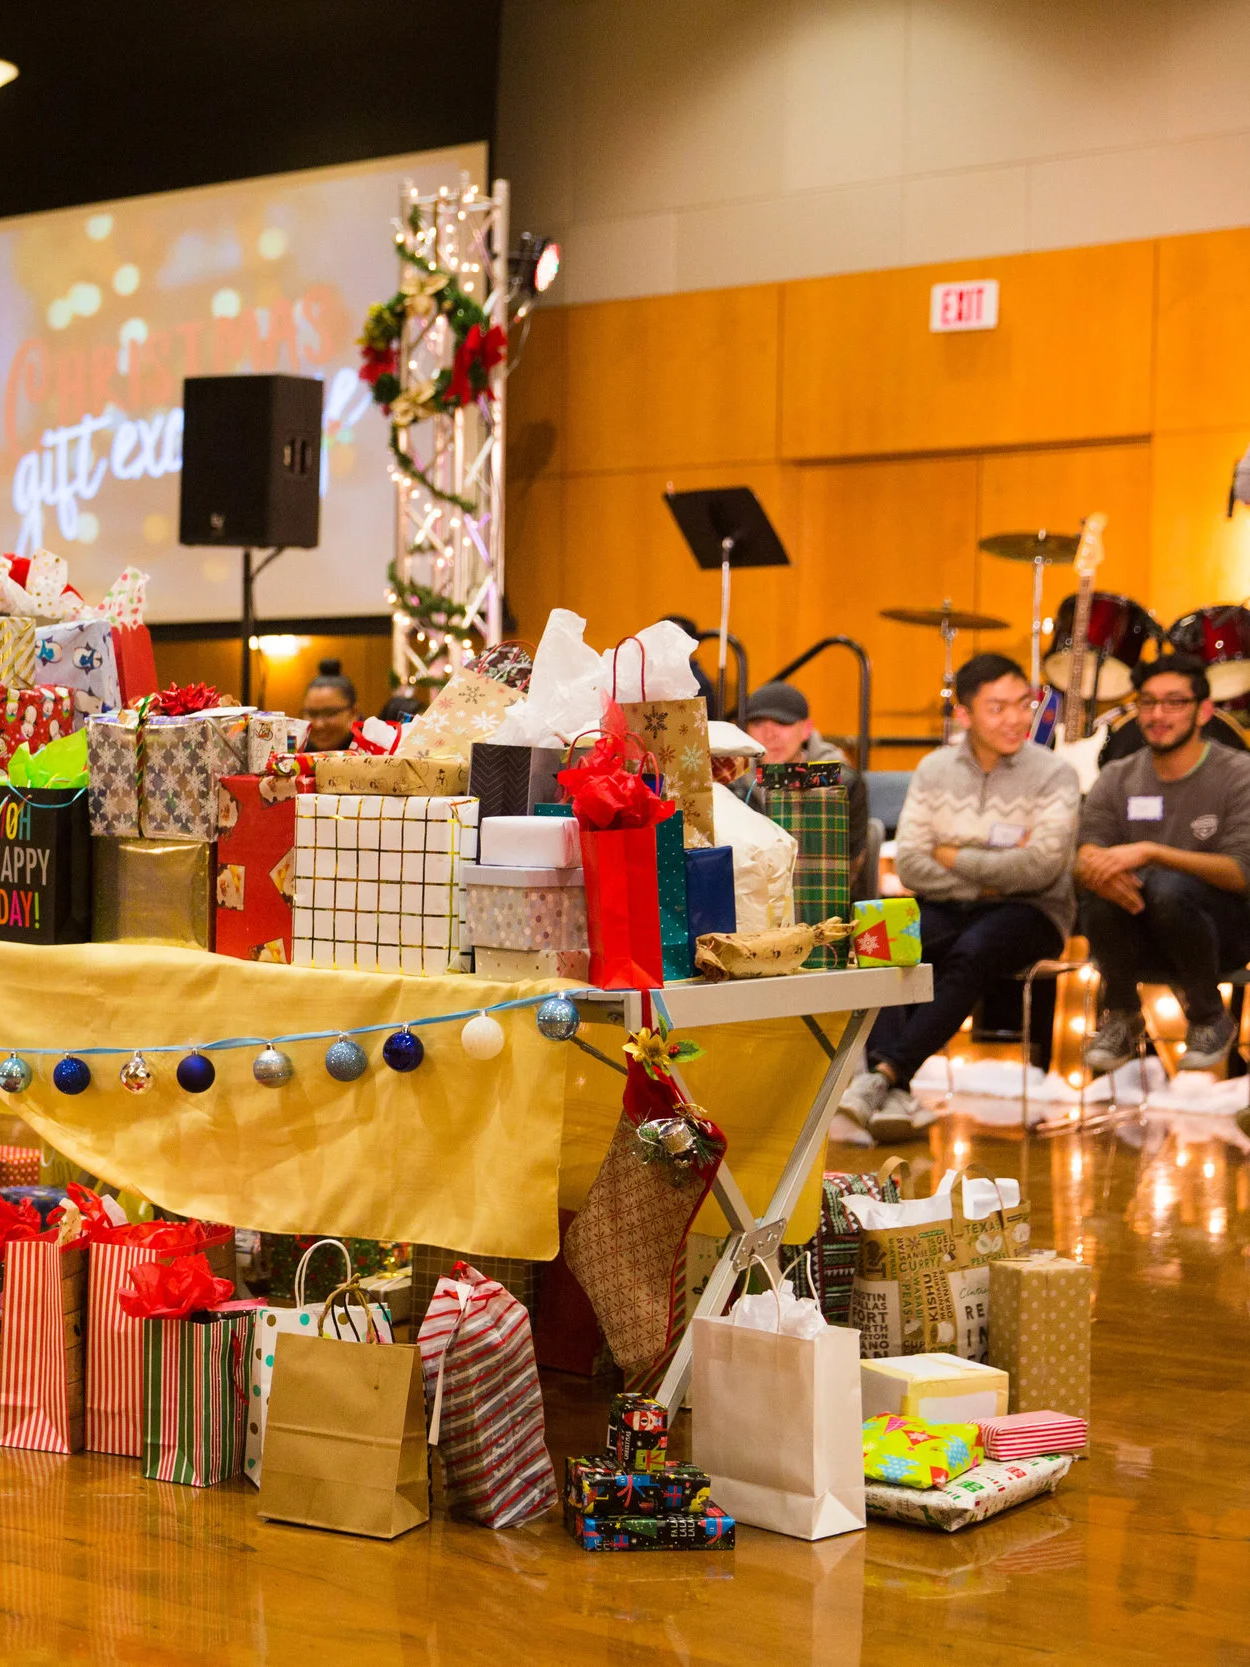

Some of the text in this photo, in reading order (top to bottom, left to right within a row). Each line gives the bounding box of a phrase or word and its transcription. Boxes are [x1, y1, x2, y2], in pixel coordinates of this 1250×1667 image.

[940, 287, 984, 326] EXIT
[13, 413, 112, 557] gift
[852, 1306, 888, 1324] FORT
[901, 1283, 912, 1316] PEAS
[923, 1273, 939, 1322] KISHU
[933, 1271, 946, 1320] MANDARIN
[938, 1269, 954, 1319] ORANGES
